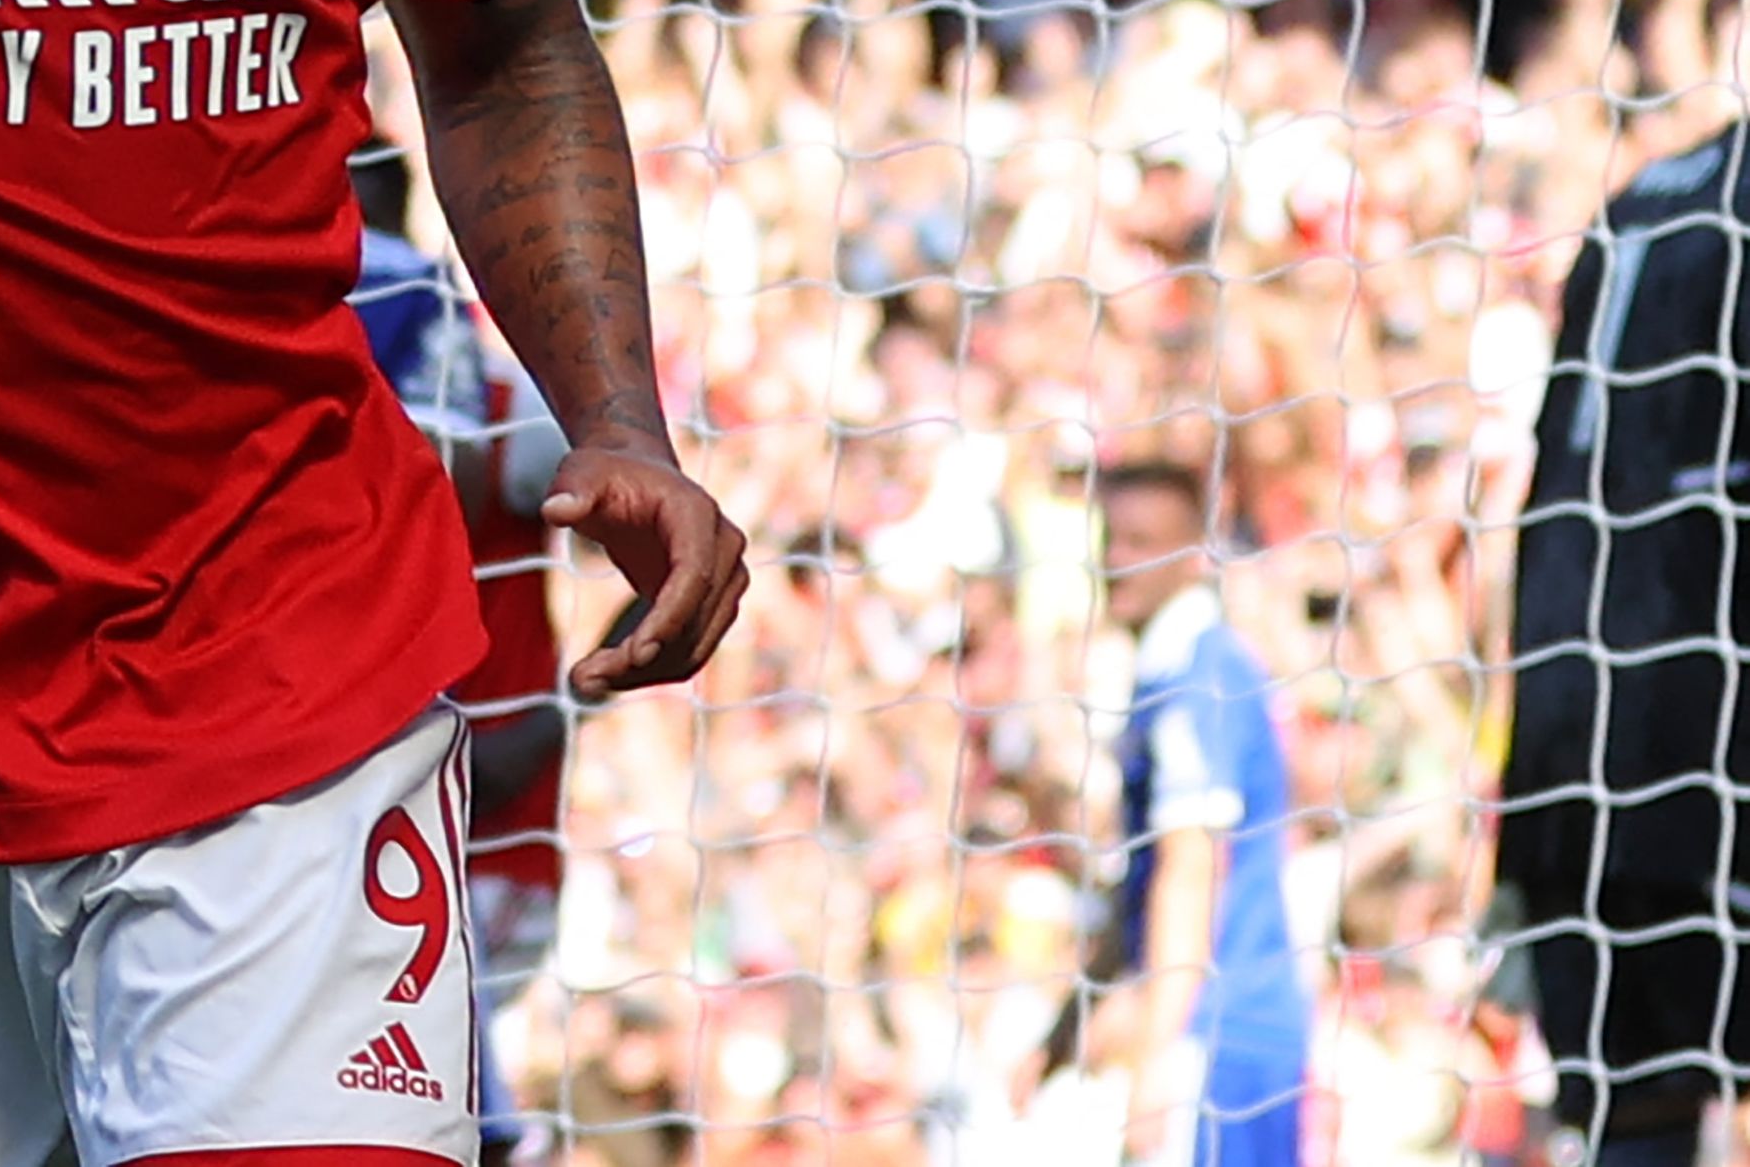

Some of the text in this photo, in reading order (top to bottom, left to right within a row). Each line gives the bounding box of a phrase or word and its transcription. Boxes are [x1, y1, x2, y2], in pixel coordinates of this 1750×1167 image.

[72, 14, 307, 127] BETTER
[364, 805, 450, 1004] 9
[337, 1064, 443, 1101] adidas
